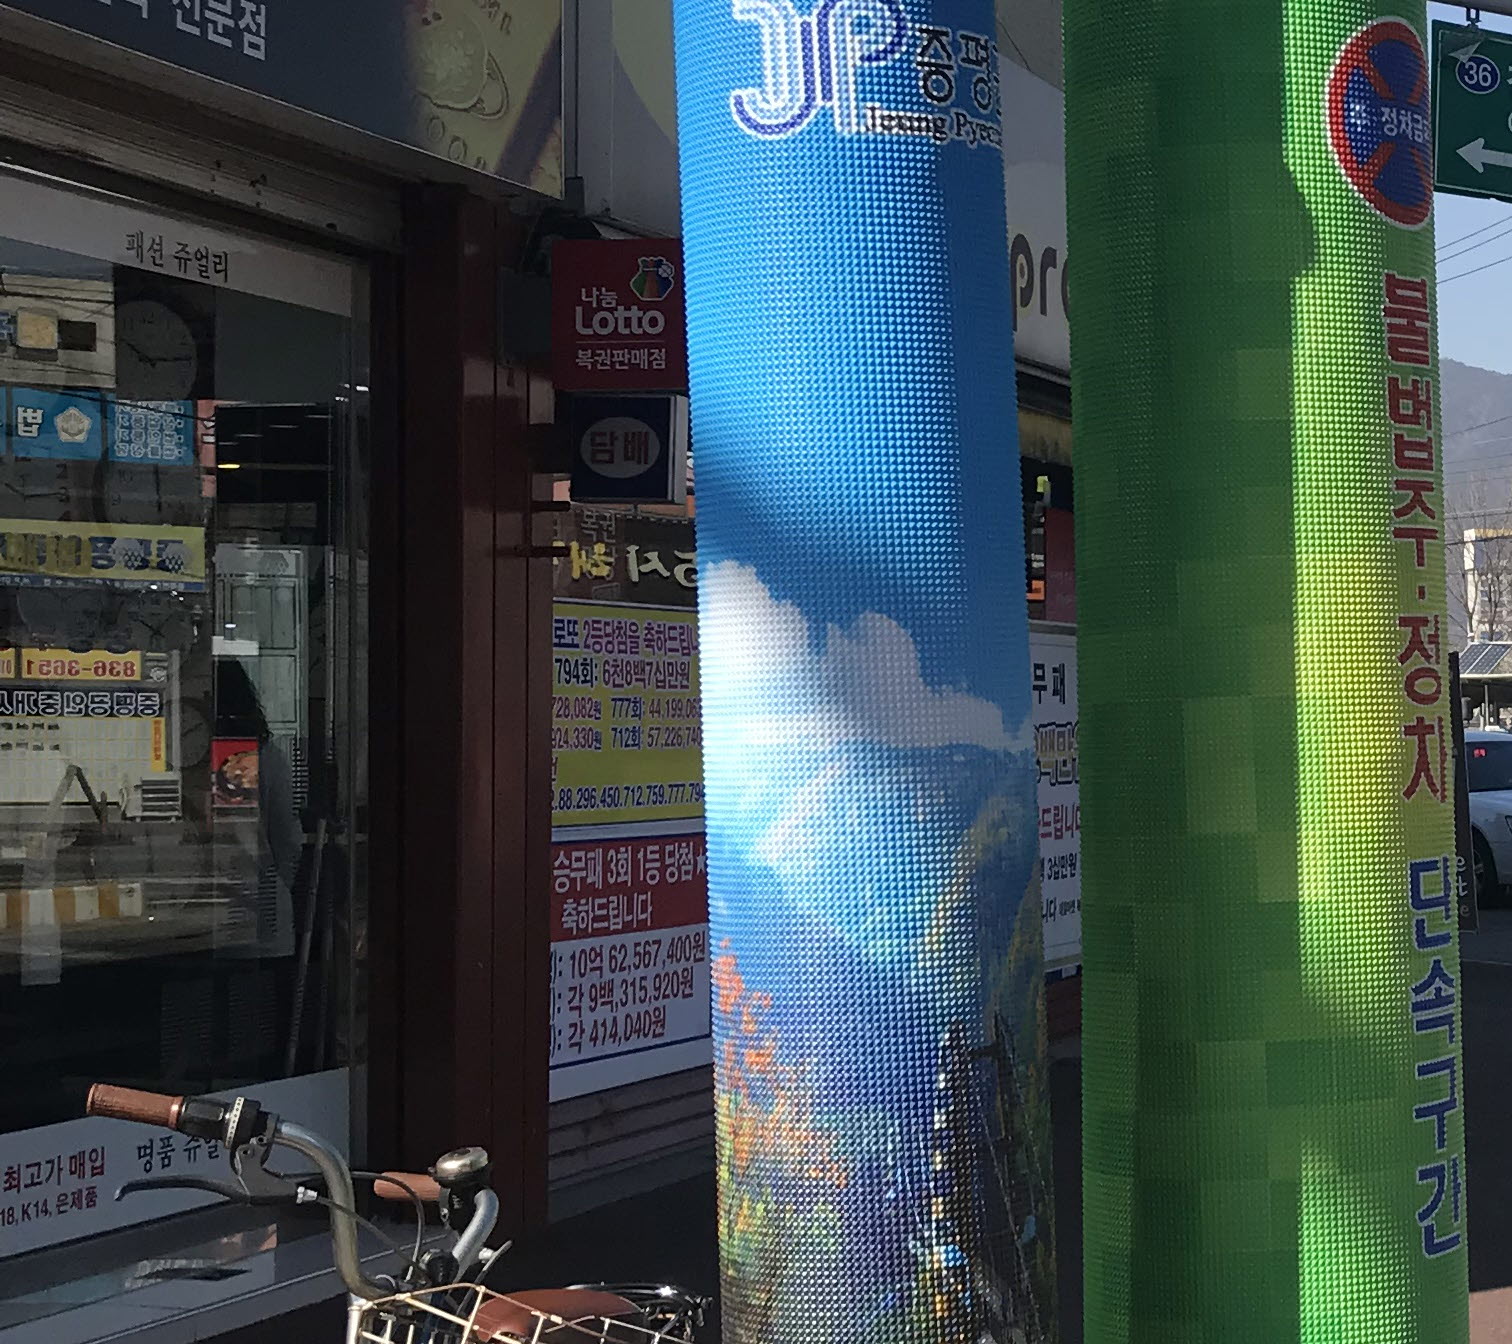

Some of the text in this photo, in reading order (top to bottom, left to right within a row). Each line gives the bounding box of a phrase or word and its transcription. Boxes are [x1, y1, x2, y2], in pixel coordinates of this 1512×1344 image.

[916, 26, 1001, 112] 증평
[1463, 60, 1493, 89] 36
[124, 230, 231, 284] 패션 쥬얼리
[581, 287, 618, 308] 나눔
[575, 306, 665, 335] Lotto
[575, 348, 667, 371] 복권판매점
[590, 430, 649, 465] 담배
[553, 617, 580, 649] 로또
[583, 619, 640, 655] 2등당첨을
[555, 657, 691, 690] 794회: 6천8백7십만원
[553, 848, 603, 894] 승무패
[607, 845, 632, 887] 3회
[637, 844, 661, 885] 1등
[562, 891, 653, 936] 축하드립니다
[570, 930, 705, 980] 10억 62,567,400원
[568, 985, 583, 1019] 각
[568, 1004, 666, 1054] 각 414,040원
[2, 1153, 64, 1195] 최고가
[68, 1146, 107, 1178] 매입
[136, 1135, 175, 1174] 명품
[20, 1199, 53, 1223] K14,
[55, 1186, 98, 1216] 은제품
